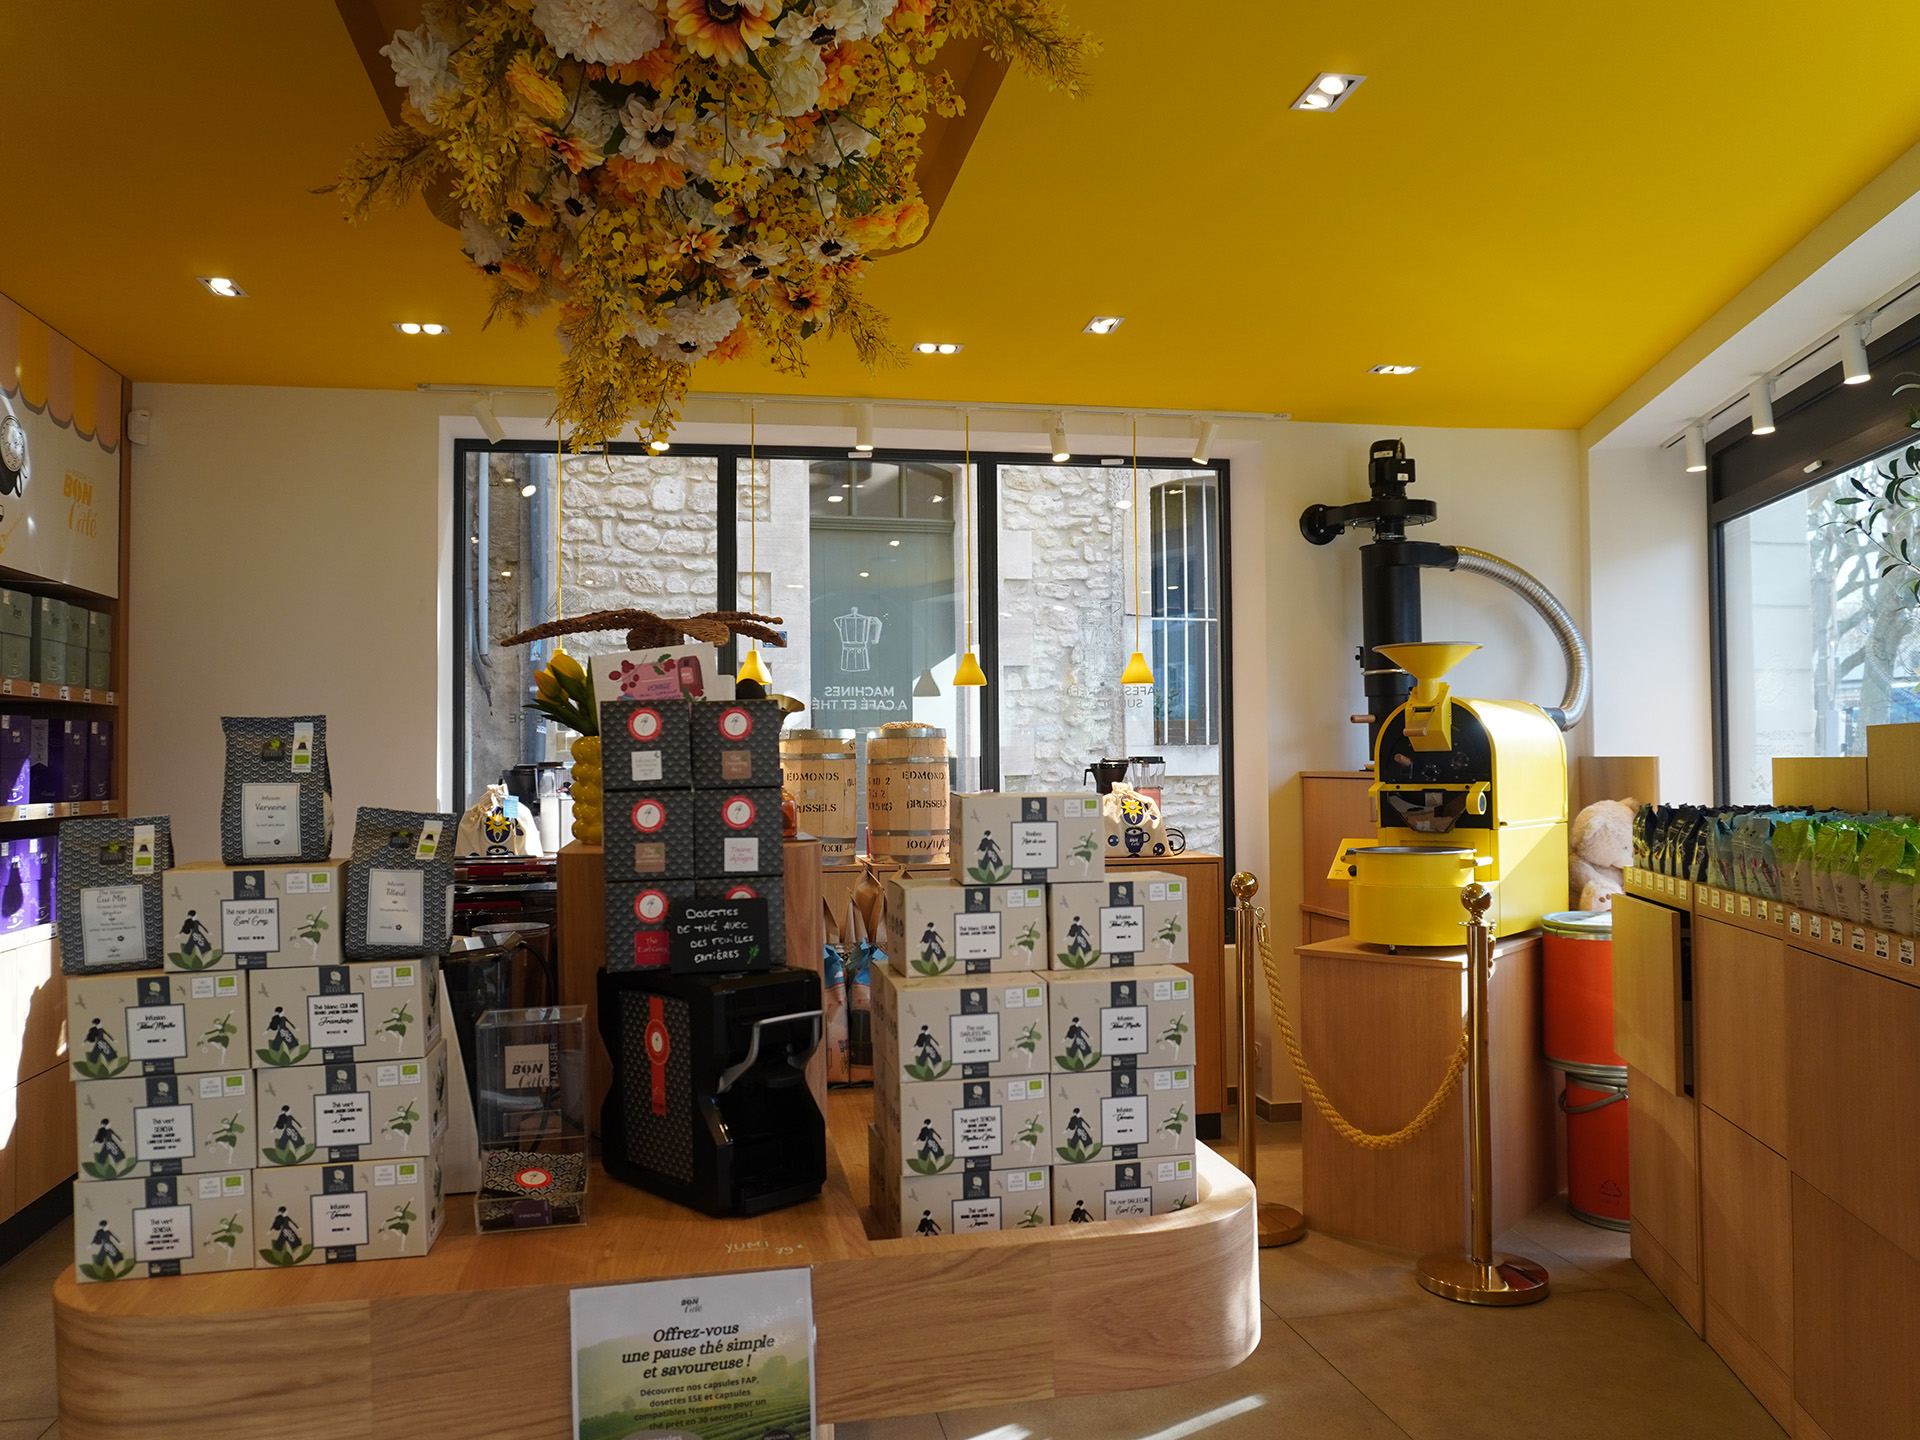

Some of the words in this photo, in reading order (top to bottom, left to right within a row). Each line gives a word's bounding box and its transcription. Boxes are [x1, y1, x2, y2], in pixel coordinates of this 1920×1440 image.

[64, 474, 93, 506] BON
[786, 772, 839, 782] EDMONDS
[255, 803, 287, 812] Verveine
[795, 803, 837, 813] RUSSELS
[906, 799, 947, 809] BRUSSELS
[677, 925, 690, 934] DE
[694, 920, 718, 932] THÉ
[723, 921, 749, 930] AVEC
[690, 939, 708, 948] DES
[512, 1063, 544, 1075] BON
[550, 1042, 559, 1087] PLAISIR
[653, 1324, 740, 1343] Offrez-vous
[622, 1350, 650, 1364] une
[652, 1346, 696, 1364] pause
[700, 1340, 724, 1355] thé
[726, 1335, 775, 1354] simple
[643, 1366, 657, 1379] et
[661, 1358, 744, 1377] savoureuse
[640, 1384, 684, 1397] Découvrez
[704, 1378, 740, 1392] capsules
[650, 1396, 686, 1408] dosettes
[688, 1394, 702, 1402] ESE
[704, 1393, 713, 1401] et
[714, 1389, 751, 1402] capsules
[634, 1408, 686, 1421] compatibles
[688, 1402, 732, 1416] Nespresso
[734, 1401, 753, 1412] pour
[649, 1422, 664, 1430] thé
[698, 1415, 709, 1424] 30
[710, 1410, 748, 1422] secondes
